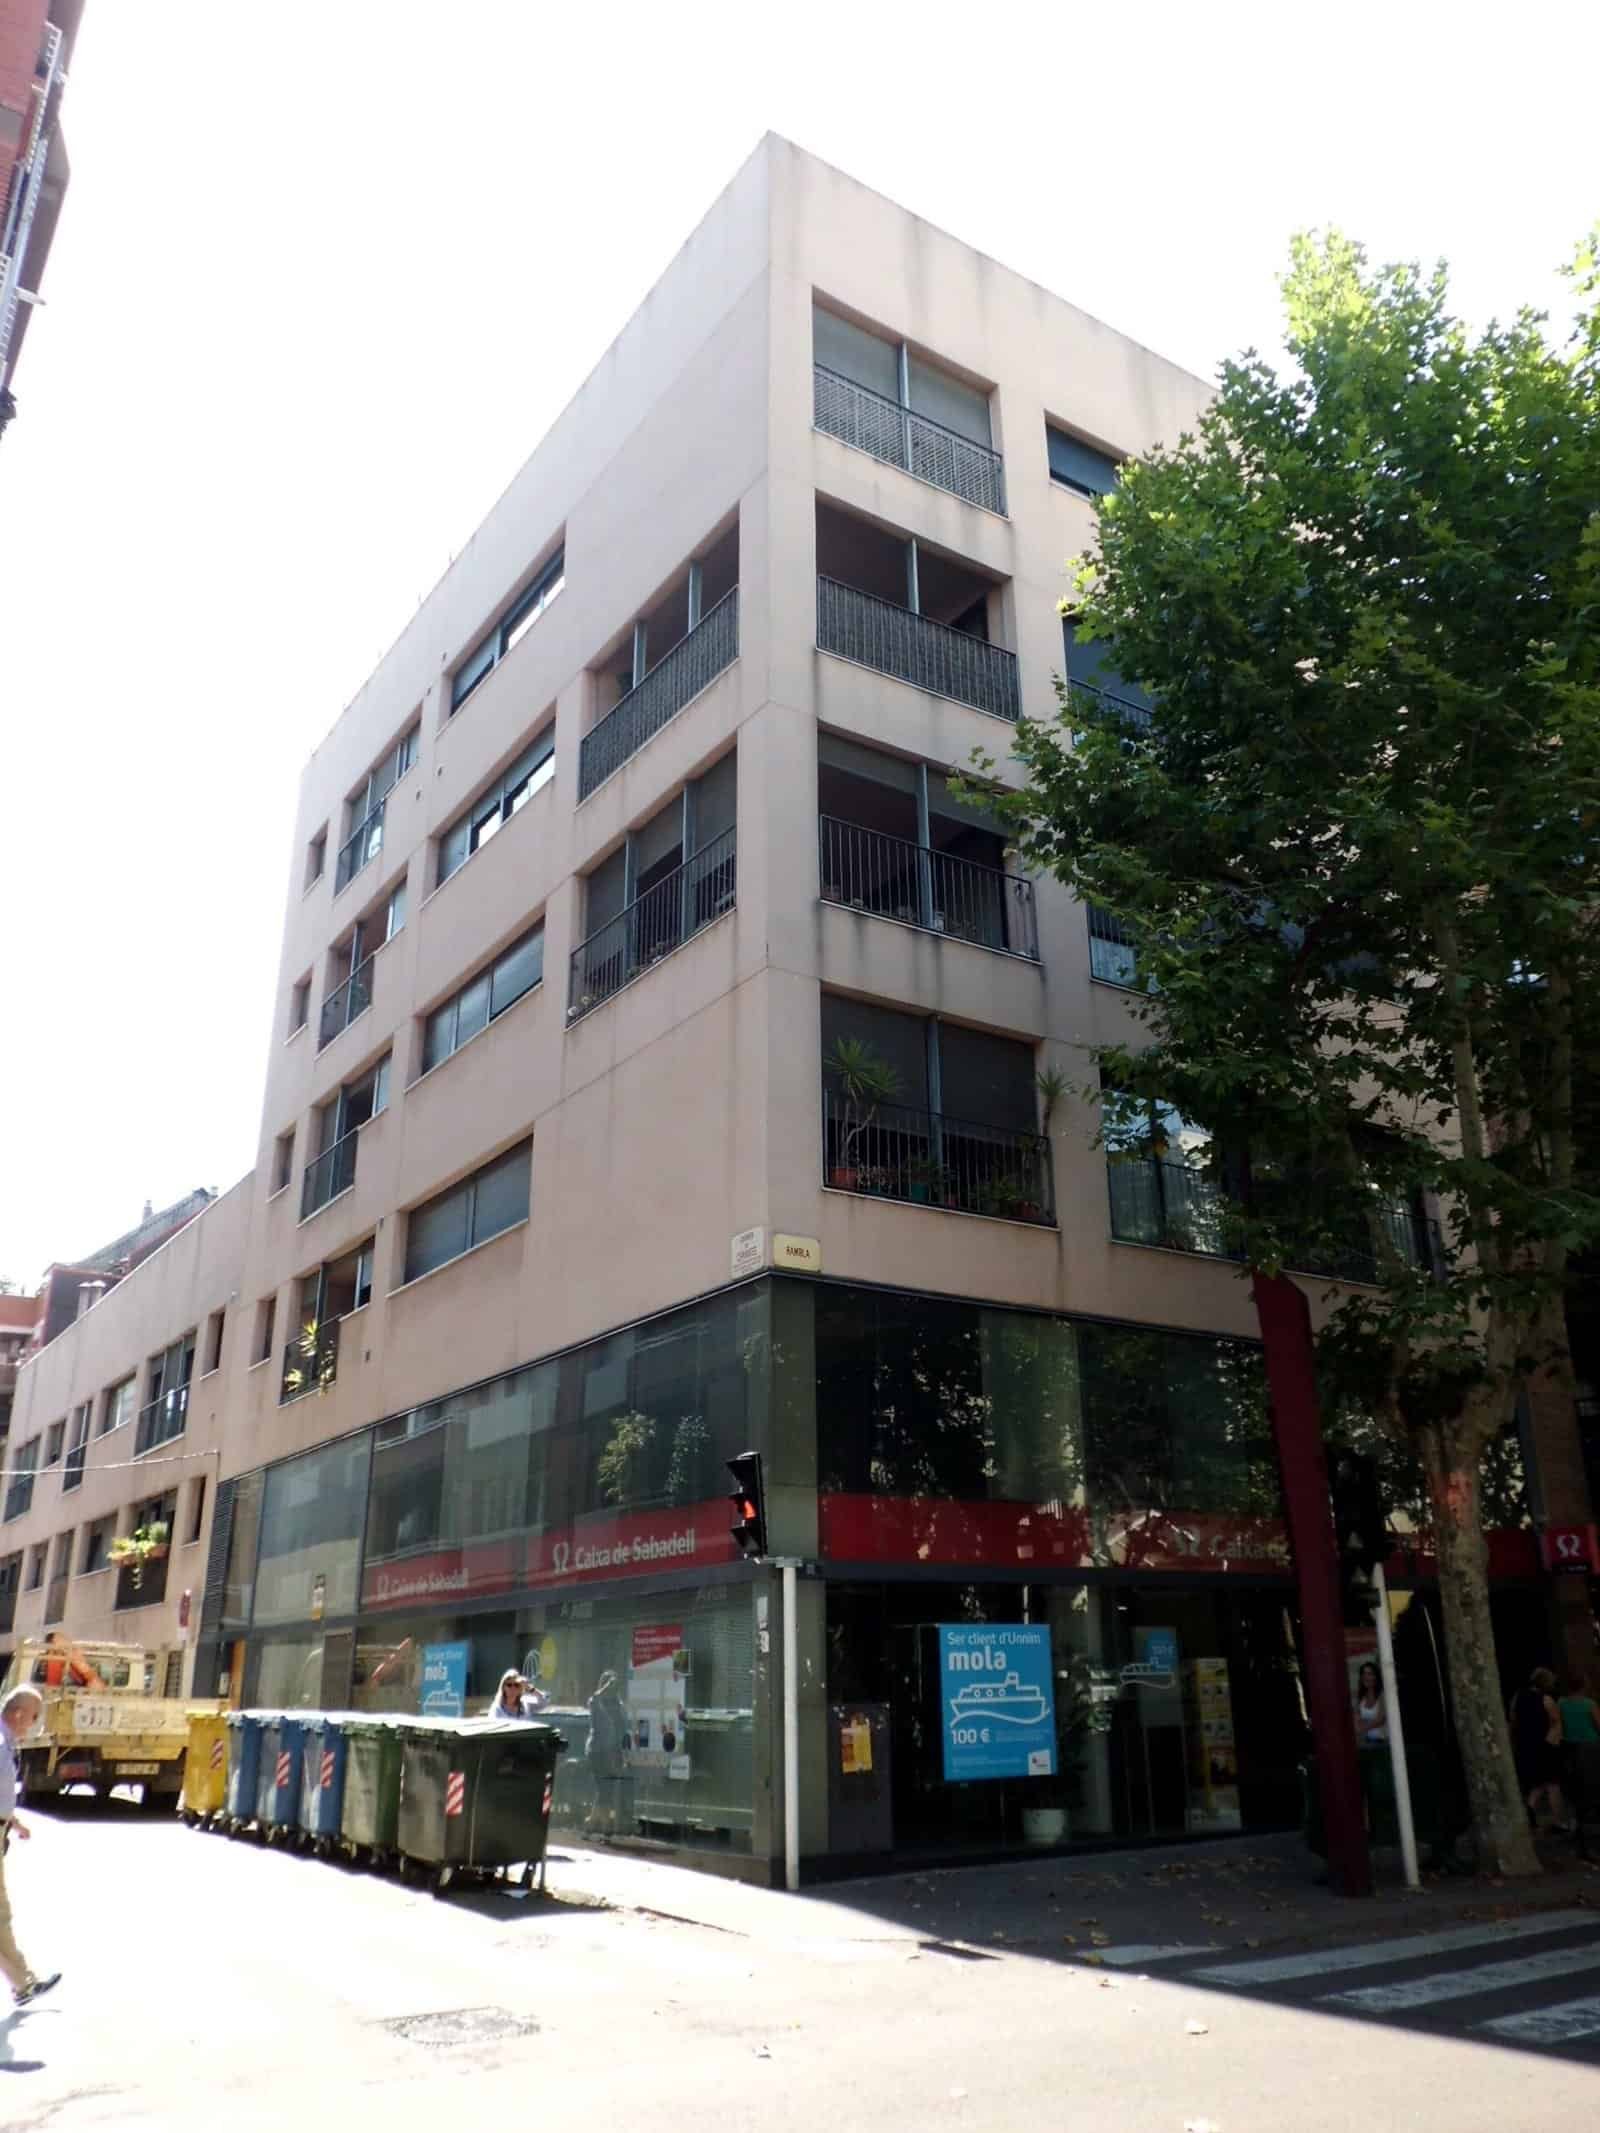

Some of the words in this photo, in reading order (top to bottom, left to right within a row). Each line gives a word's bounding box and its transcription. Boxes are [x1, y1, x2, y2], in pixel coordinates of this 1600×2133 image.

[786, 1245, 810, 1258] RAMBLA
[575, 1545, 610, 1570] Caixa
[612, 1541, 631, 1563] de
[632, 1528, 696, 1562] Sabadell
[947, 1631, 965, 1646] Ser
[967, 1631, 997, 1646] client
[999, 1631, 1041, 1646] d'Unnim
[948, 1645, 1008, 1672] mola
[951, 1728, 977, 1745] 100
[979, 1727, 991, 1744] €
